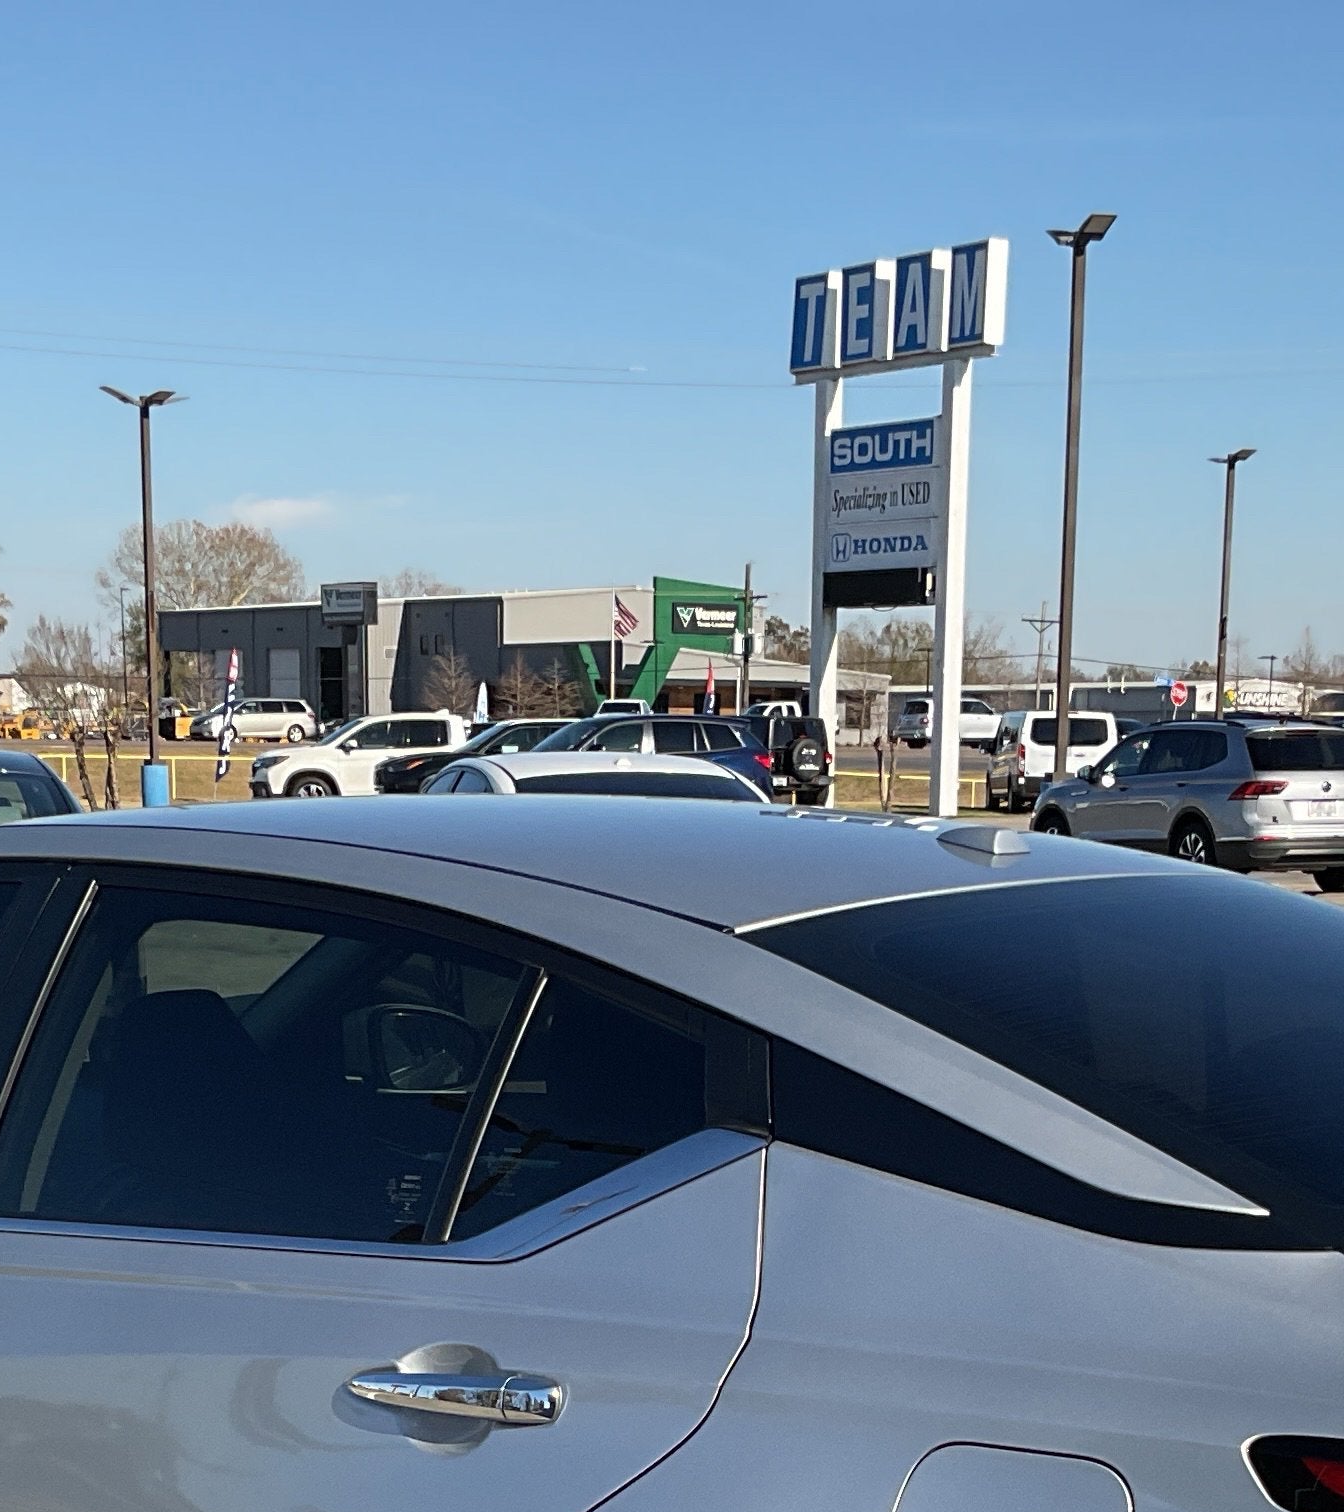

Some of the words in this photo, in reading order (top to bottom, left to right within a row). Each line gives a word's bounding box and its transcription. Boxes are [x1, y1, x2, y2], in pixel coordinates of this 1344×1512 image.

[799, 245, 986, 363] TEAM
[833, 429, 932, 467] SOUTH
[832, 486, 888, 518] Specializing
[889, 484, 899, 507] in
[901, 481, 931, 507] USED
[852, 535, 929, 555] HONDA
[1238, 691, 1288, 708] SUNSHINE
